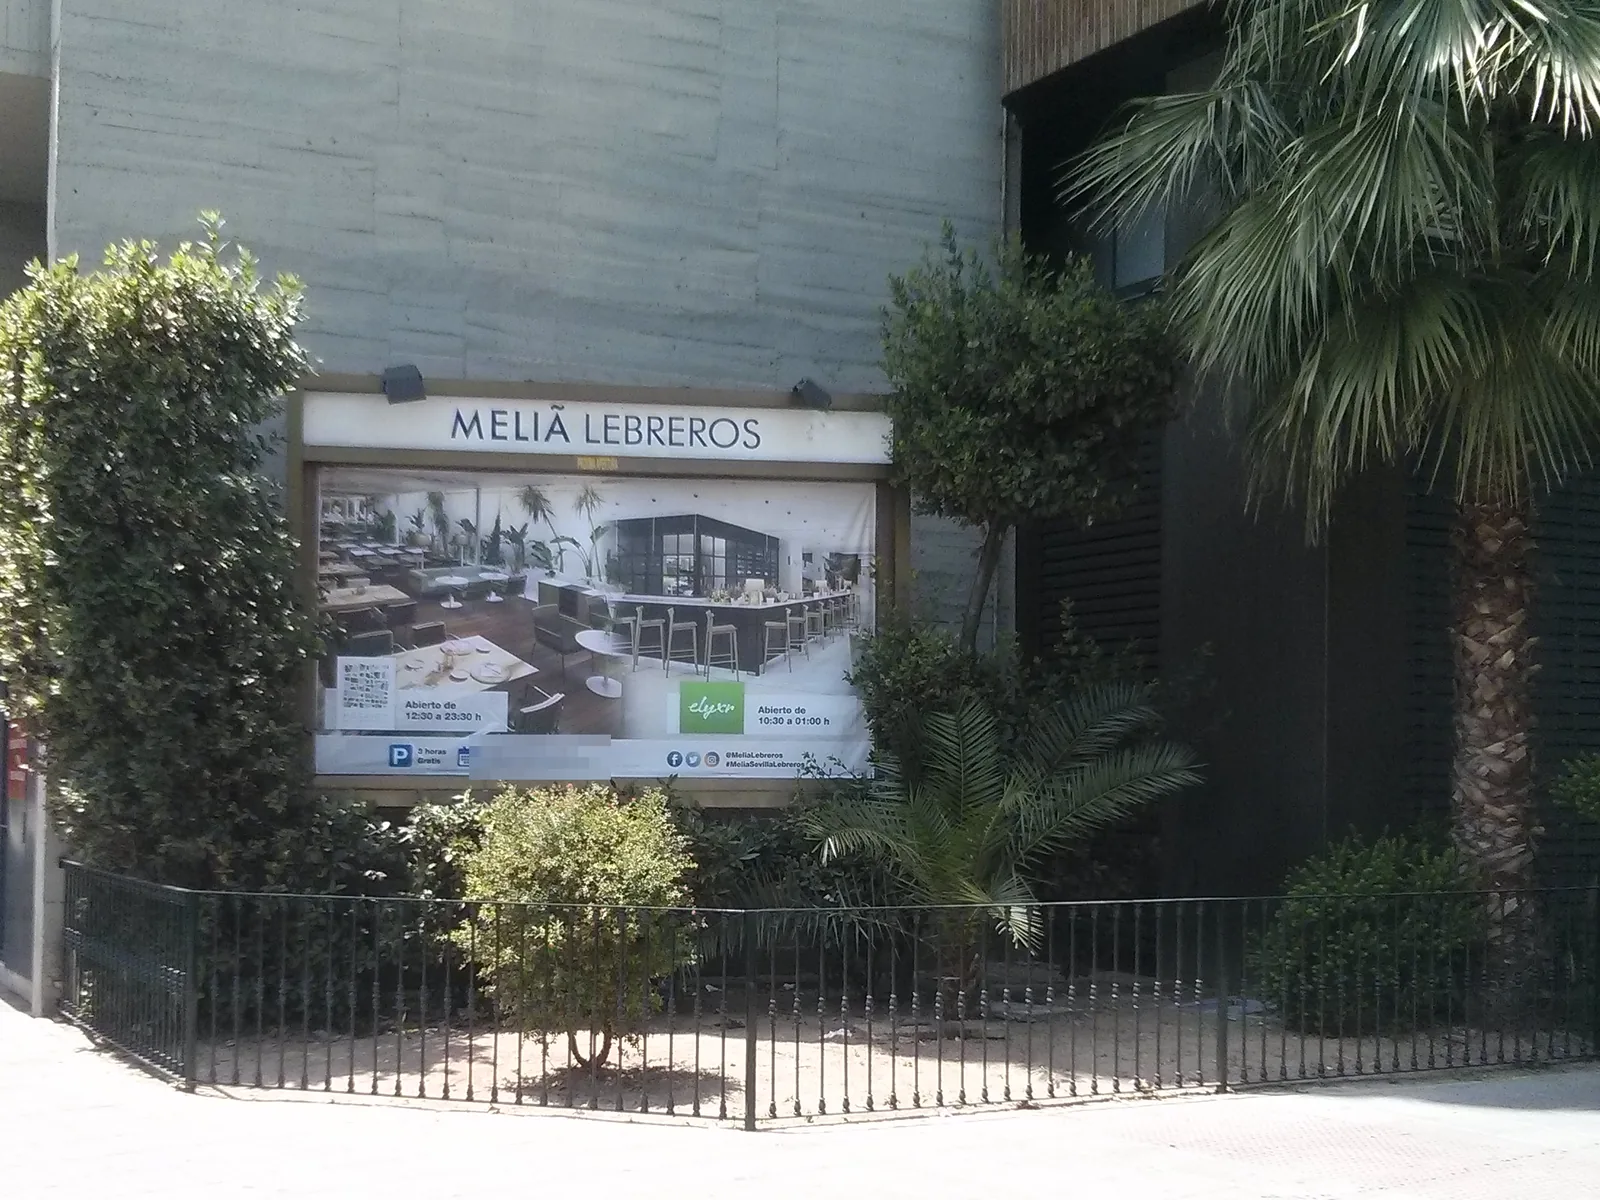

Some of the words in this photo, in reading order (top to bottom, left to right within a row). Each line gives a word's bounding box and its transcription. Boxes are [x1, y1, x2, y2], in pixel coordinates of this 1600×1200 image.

[585, 413, 761, 450] LEBREROS
[405, 700, 441, 710] Abierto
[444, 701, 457, 710] de
[758, 706, 792, 715] Abierto
[794, 706, 806, 715] de
[405, 711, 433, 721] 12:30
[443, 712, 473, 722] 23:30
[475, 712, 482, 722] h
[758, 717, 785, 726] 10:30
[795, 717, 821, 726] 01:00
[824, 717, 830, 726] h
[417, 747, 423, 755] 3
[425, 747, 447, 755] horas
[725, 751, 783, 759] @MeliaLebreros
[393, 747, 409, 765] P
[417, 757, 441, 765] Gratis
[725, 760, 805, 769] #MeliaSevillaLebreros
